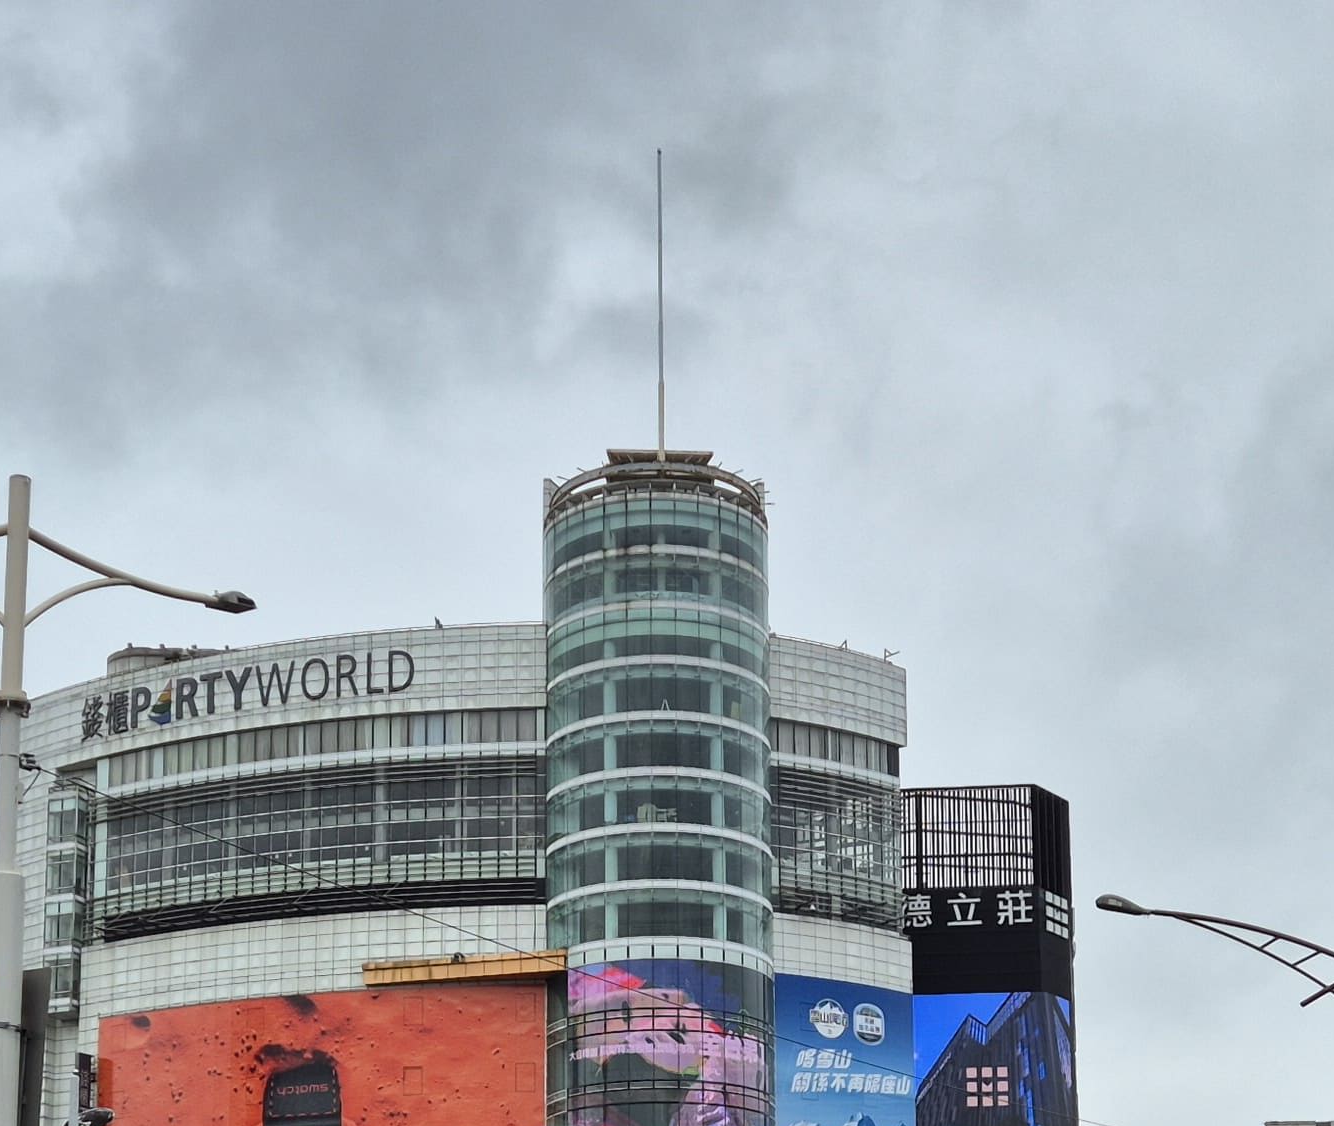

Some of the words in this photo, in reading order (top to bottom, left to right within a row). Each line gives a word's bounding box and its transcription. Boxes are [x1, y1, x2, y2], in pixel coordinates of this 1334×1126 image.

[902, 889, 1034, 928] 德立莊
[277, 1082, 329, 1096] swatch
